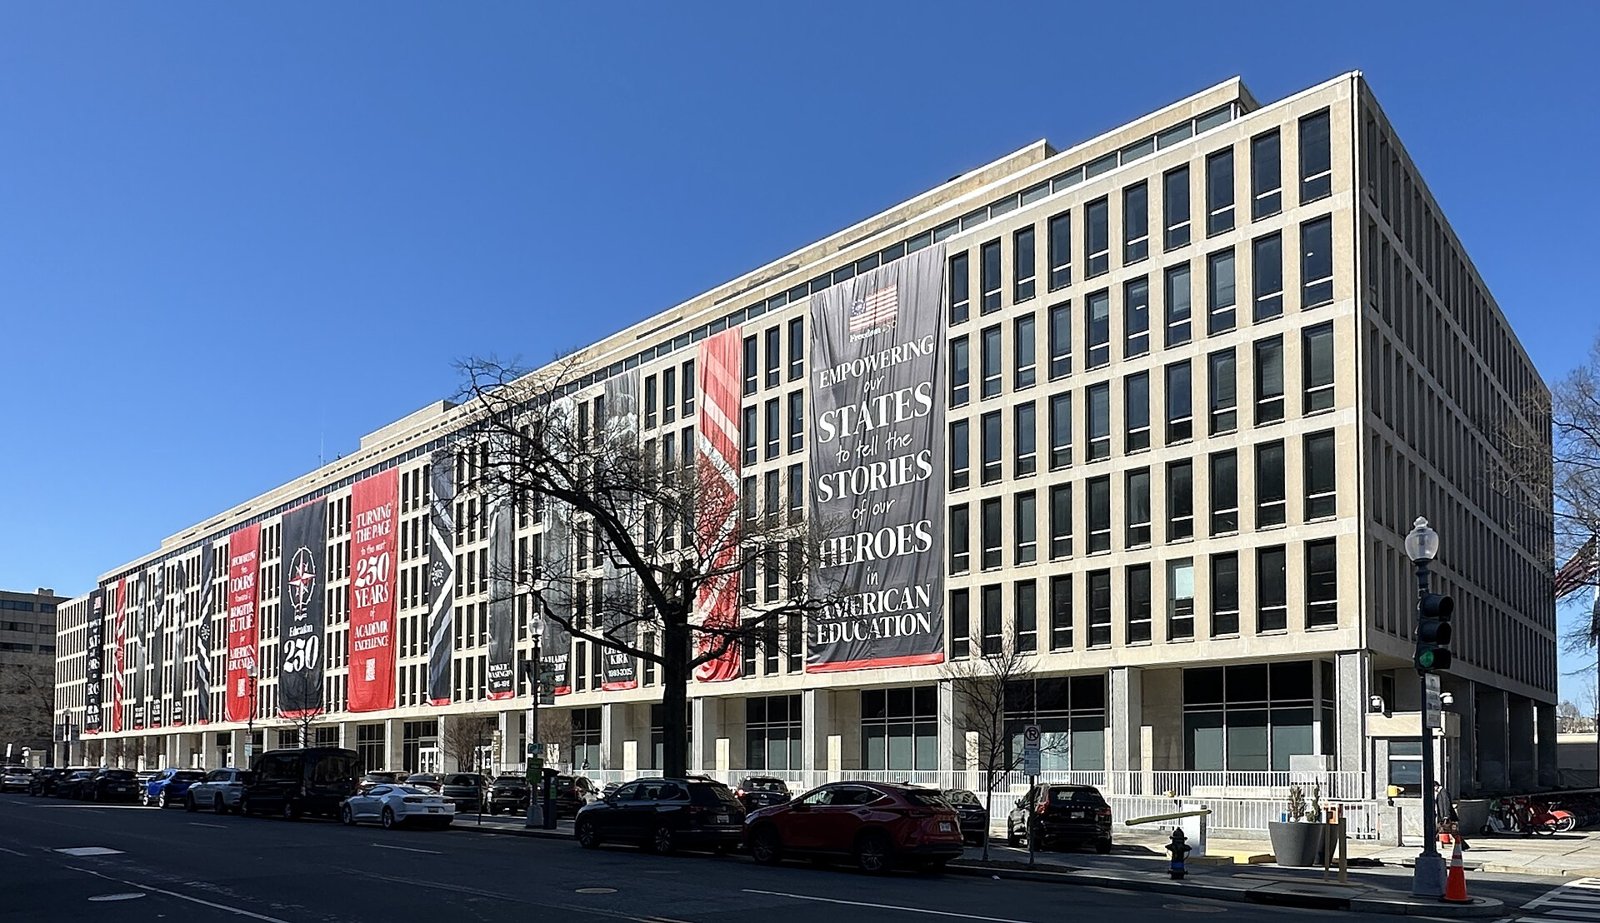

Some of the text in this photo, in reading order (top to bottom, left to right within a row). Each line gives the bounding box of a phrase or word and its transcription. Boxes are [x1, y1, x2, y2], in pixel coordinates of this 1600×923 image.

[819, 335, 935, 389] EMPOWERING
[863, 375, 885, 393] our
[818, 381, 933, 444] STATES
[835, 431, 913, 466] to tell the
[818, 449, 933, 503] STORIES
[356, 502, 392, 529] TURNING
[852, 499, 896, 526] of our
[355, 519, 392, 544] THE PAGE
[819, 519, 933, 569] HEROES
[354, 551, 390, 588] 250
[866, 566, 878, 586] in
[354, 581, 389, 609] YEARS
[817, 584, 931, 621] AMERICAN
[289, 623, 313, 637] Education
[354, 620, 389, 639] ACADEMIC
[817, 612, 932, 645] EDUCATION
[283, 635, 319, 673] 250
[354, 635, 390, 652] EXCELLENCE
[610, 653, 629, 665] KIRK
